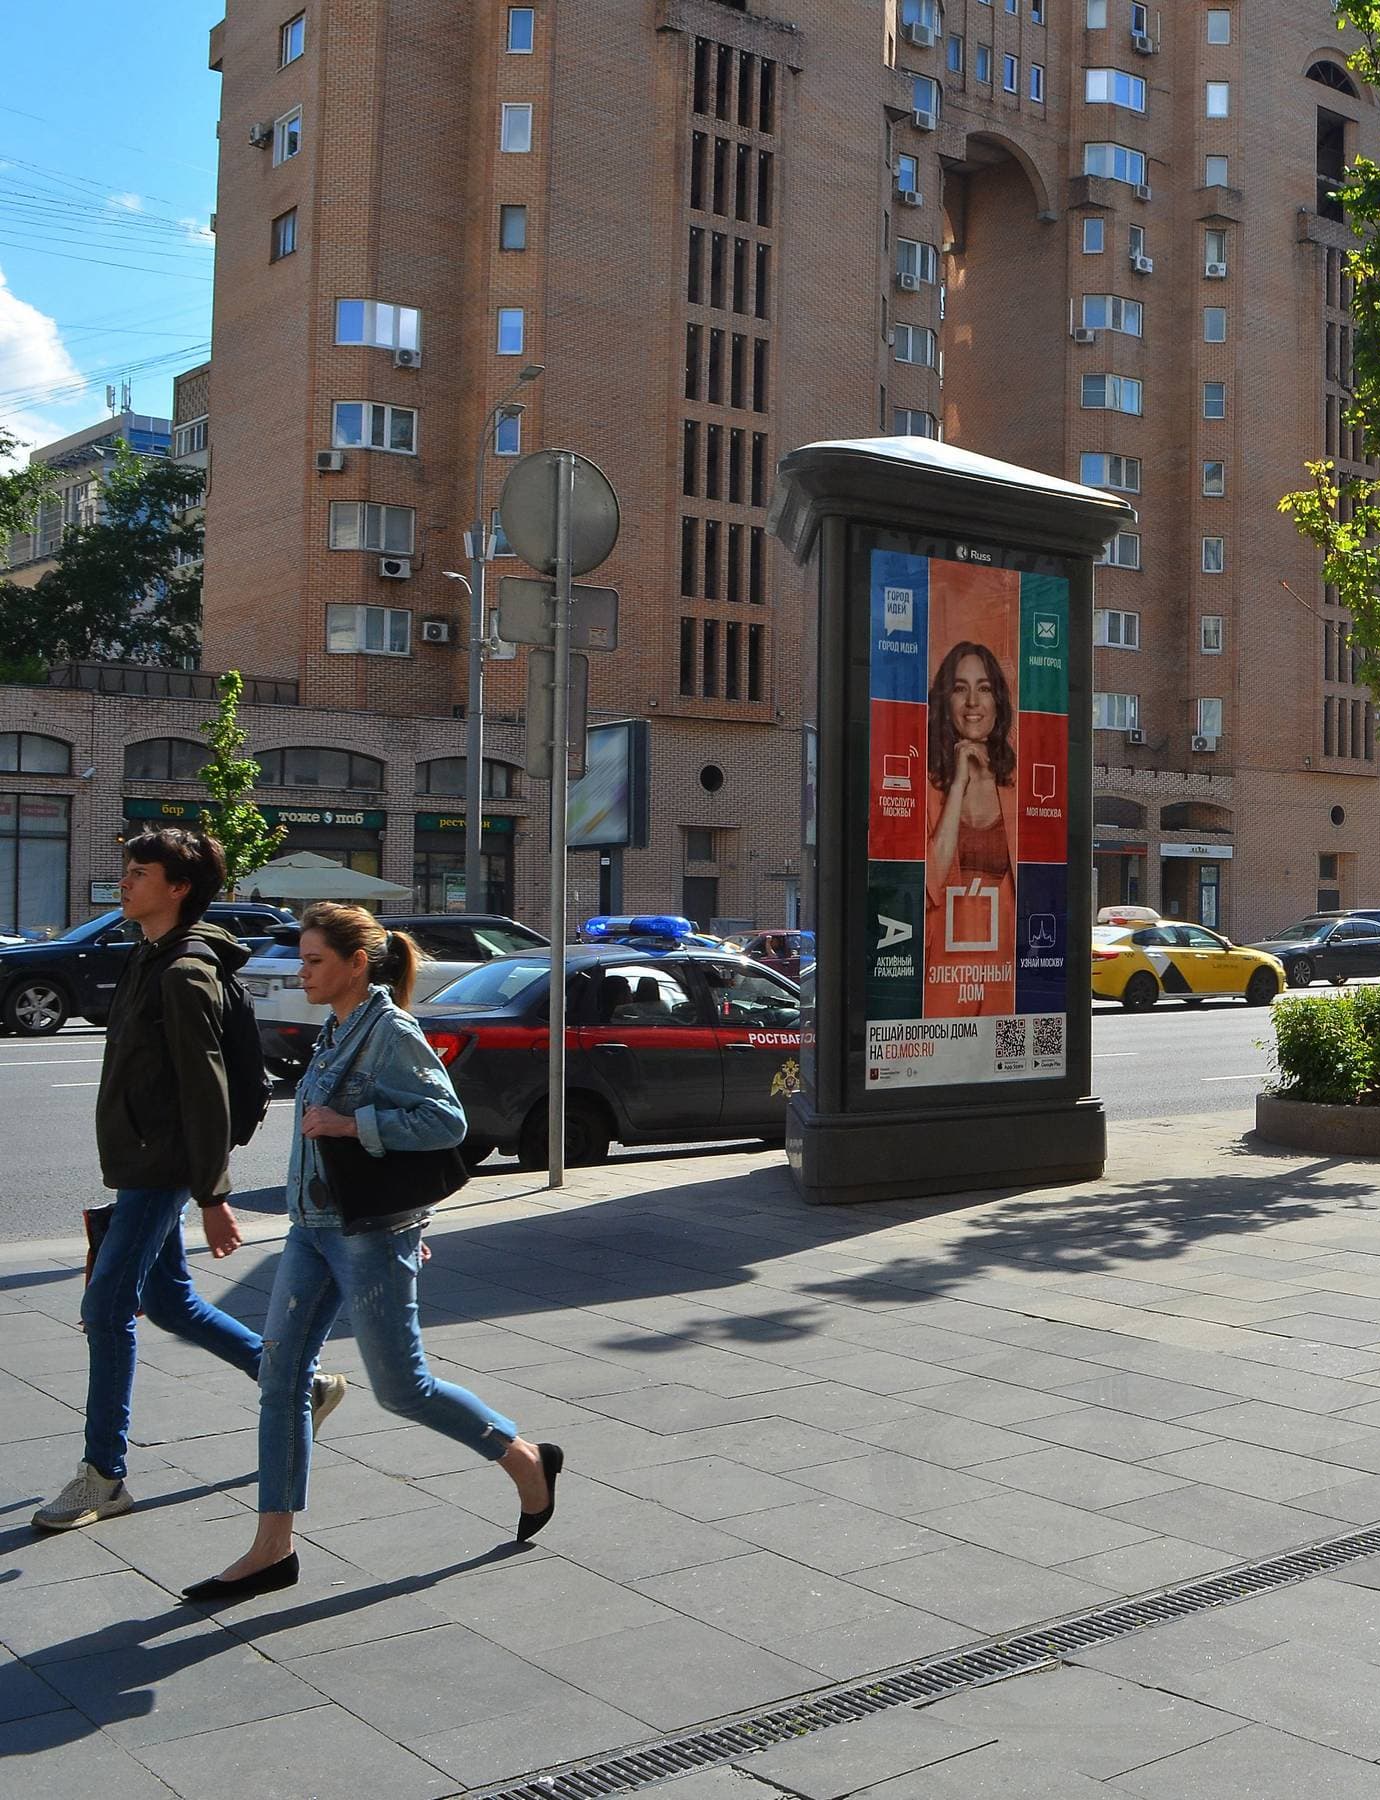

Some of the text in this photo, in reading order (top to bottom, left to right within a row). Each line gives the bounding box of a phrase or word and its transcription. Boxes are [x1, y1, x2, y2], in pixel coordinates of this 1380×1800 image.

[970, 549, 992, 562] Russ
[887, 590, 910, 603] ГОРОД
[878, 640, 918, 655] ГОРОД ИДЕЙ
[1029, 655, 1062, 669] НАШ ГОРОД
[879, 795, 916, 808] ГОСУСЛУГИ
[161, 804, 185, 816] бар
[883, 806, 911, 818] МОСКВЫ
[1026, 806, 1062, 819] МОЯ МОСКВА
[278, 811, 364, 824] тоже паб
[439, 819, 491, 829] рестн
[876, 954, 912, 967] АКТИВНЫЙ
[1020, 956, 1064, 968] УЗНАЙ МОСКВУ
[873, 966, 915, 978] ГРАЖДАНИН
[928, 961, 1012, 984] ЭЛЕКТРОННЫЙ
[957, 984, 984, 1004] ДОМ
[869, 1023, 978, 1042] РЕШАЙ ВОПРОСЫ ДОМА
[869, 1042, 935, 1060] НА ED.MOS.RU
[906, 1067, 918, 1077] 0+
